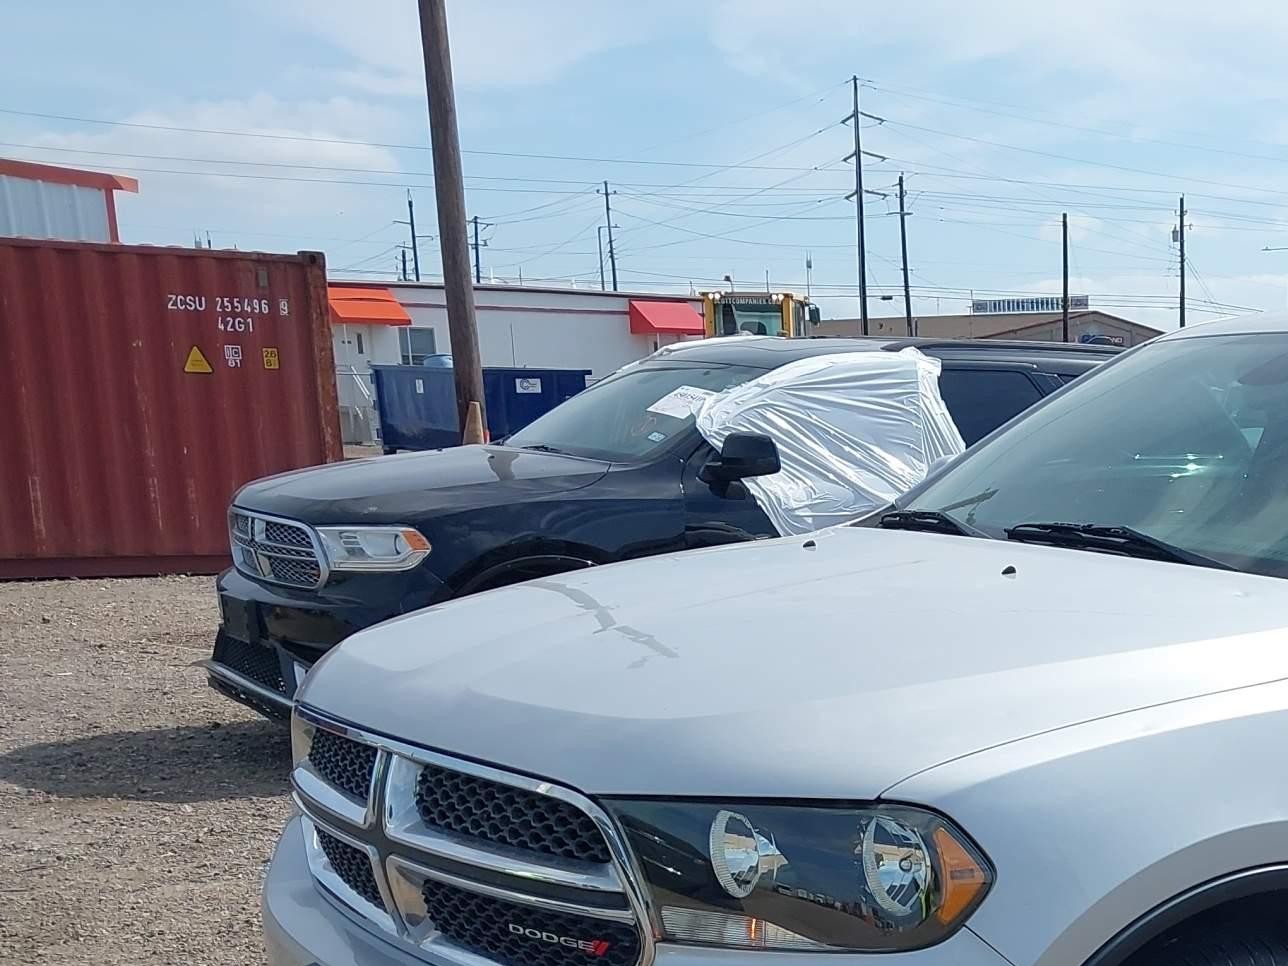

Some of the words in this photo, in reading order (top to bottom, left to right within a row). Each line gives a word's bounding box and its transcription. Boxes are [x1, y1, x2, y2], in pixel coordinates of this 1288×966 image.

[167, 295, 205, 311] ZCSU
[215, 298, 269, 314] 255496
[279, 299, 288, 315] 9
[217, 317, 253, 332] 42G1
[509, 924, 596, 952] DODGE
